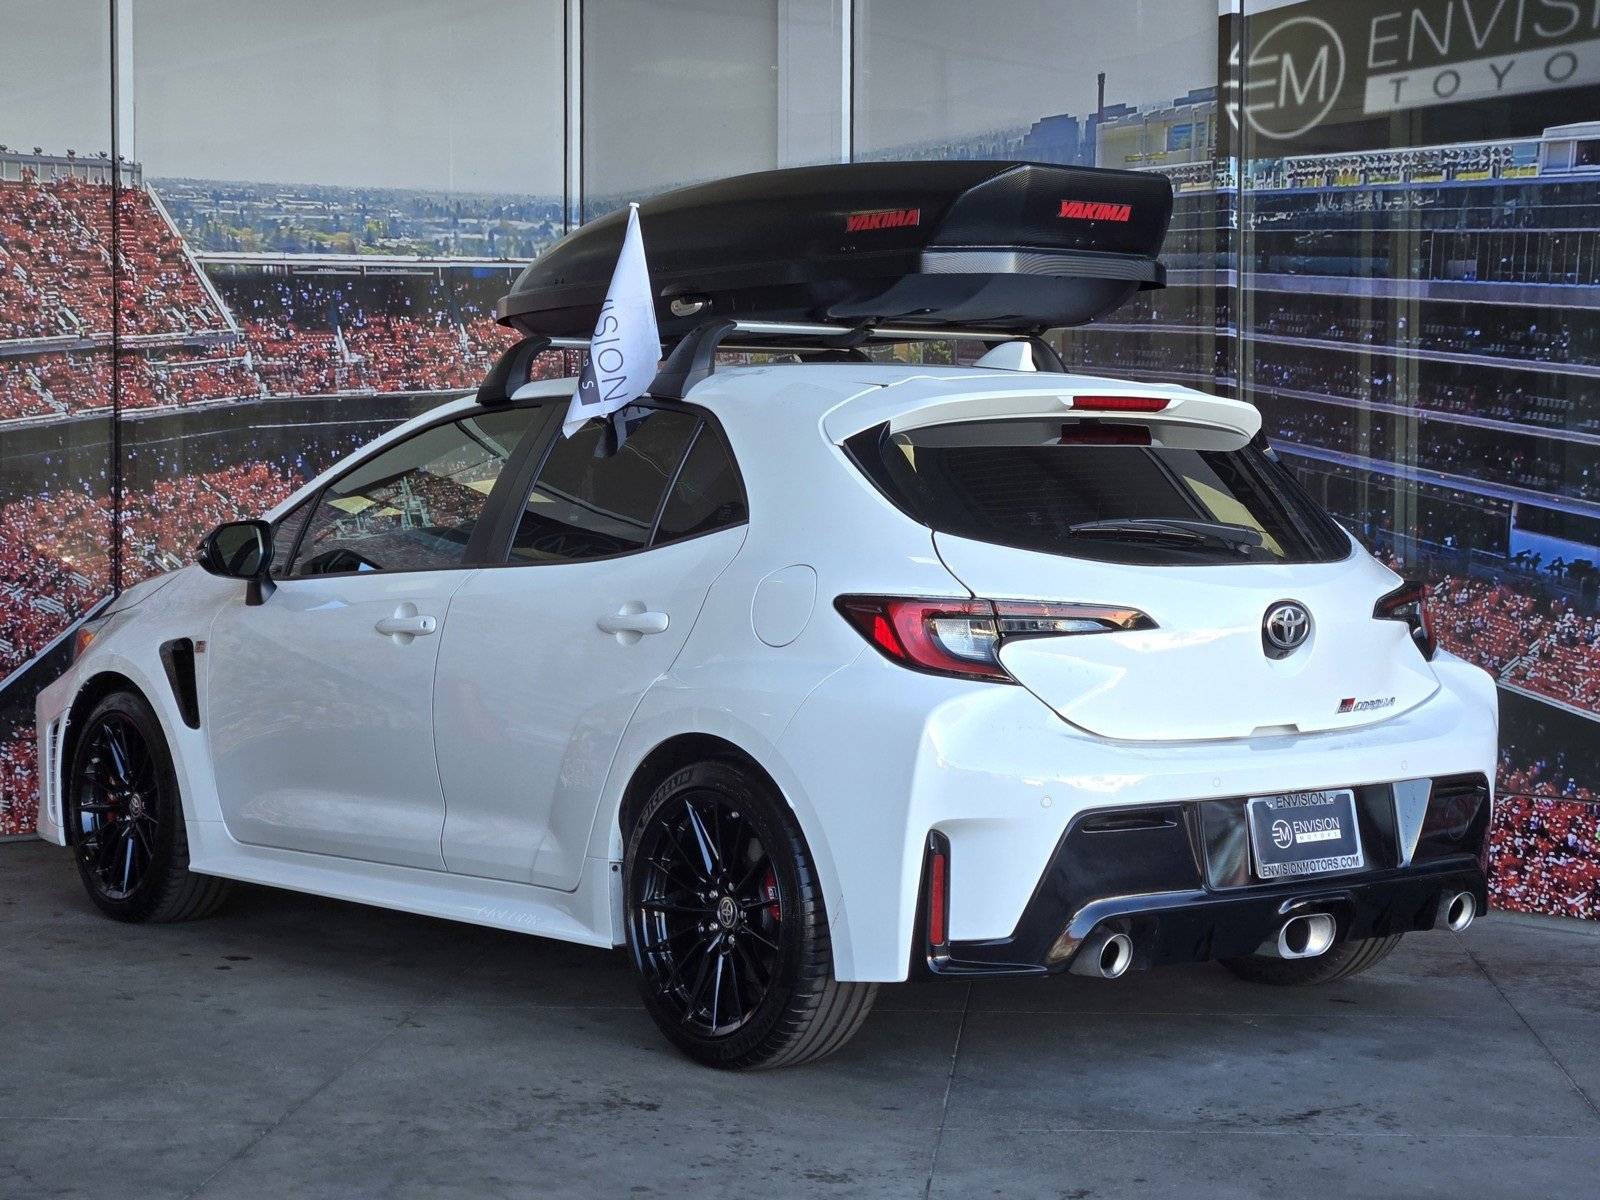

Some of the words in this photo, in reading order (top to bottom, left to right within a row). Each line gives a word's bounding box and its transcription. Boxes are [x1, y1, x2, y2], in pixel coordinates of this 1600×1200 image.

[847, 208, 919, 231] YAKIMA
[1059, 201, 1132, 221] YAKIMA
[1276, 792, 1328, 809] ENVISION
[1293, 817, 1341, 834] ENVISION
[1262, 856, 1360, 877] ENVISIONMOTORS.COM
